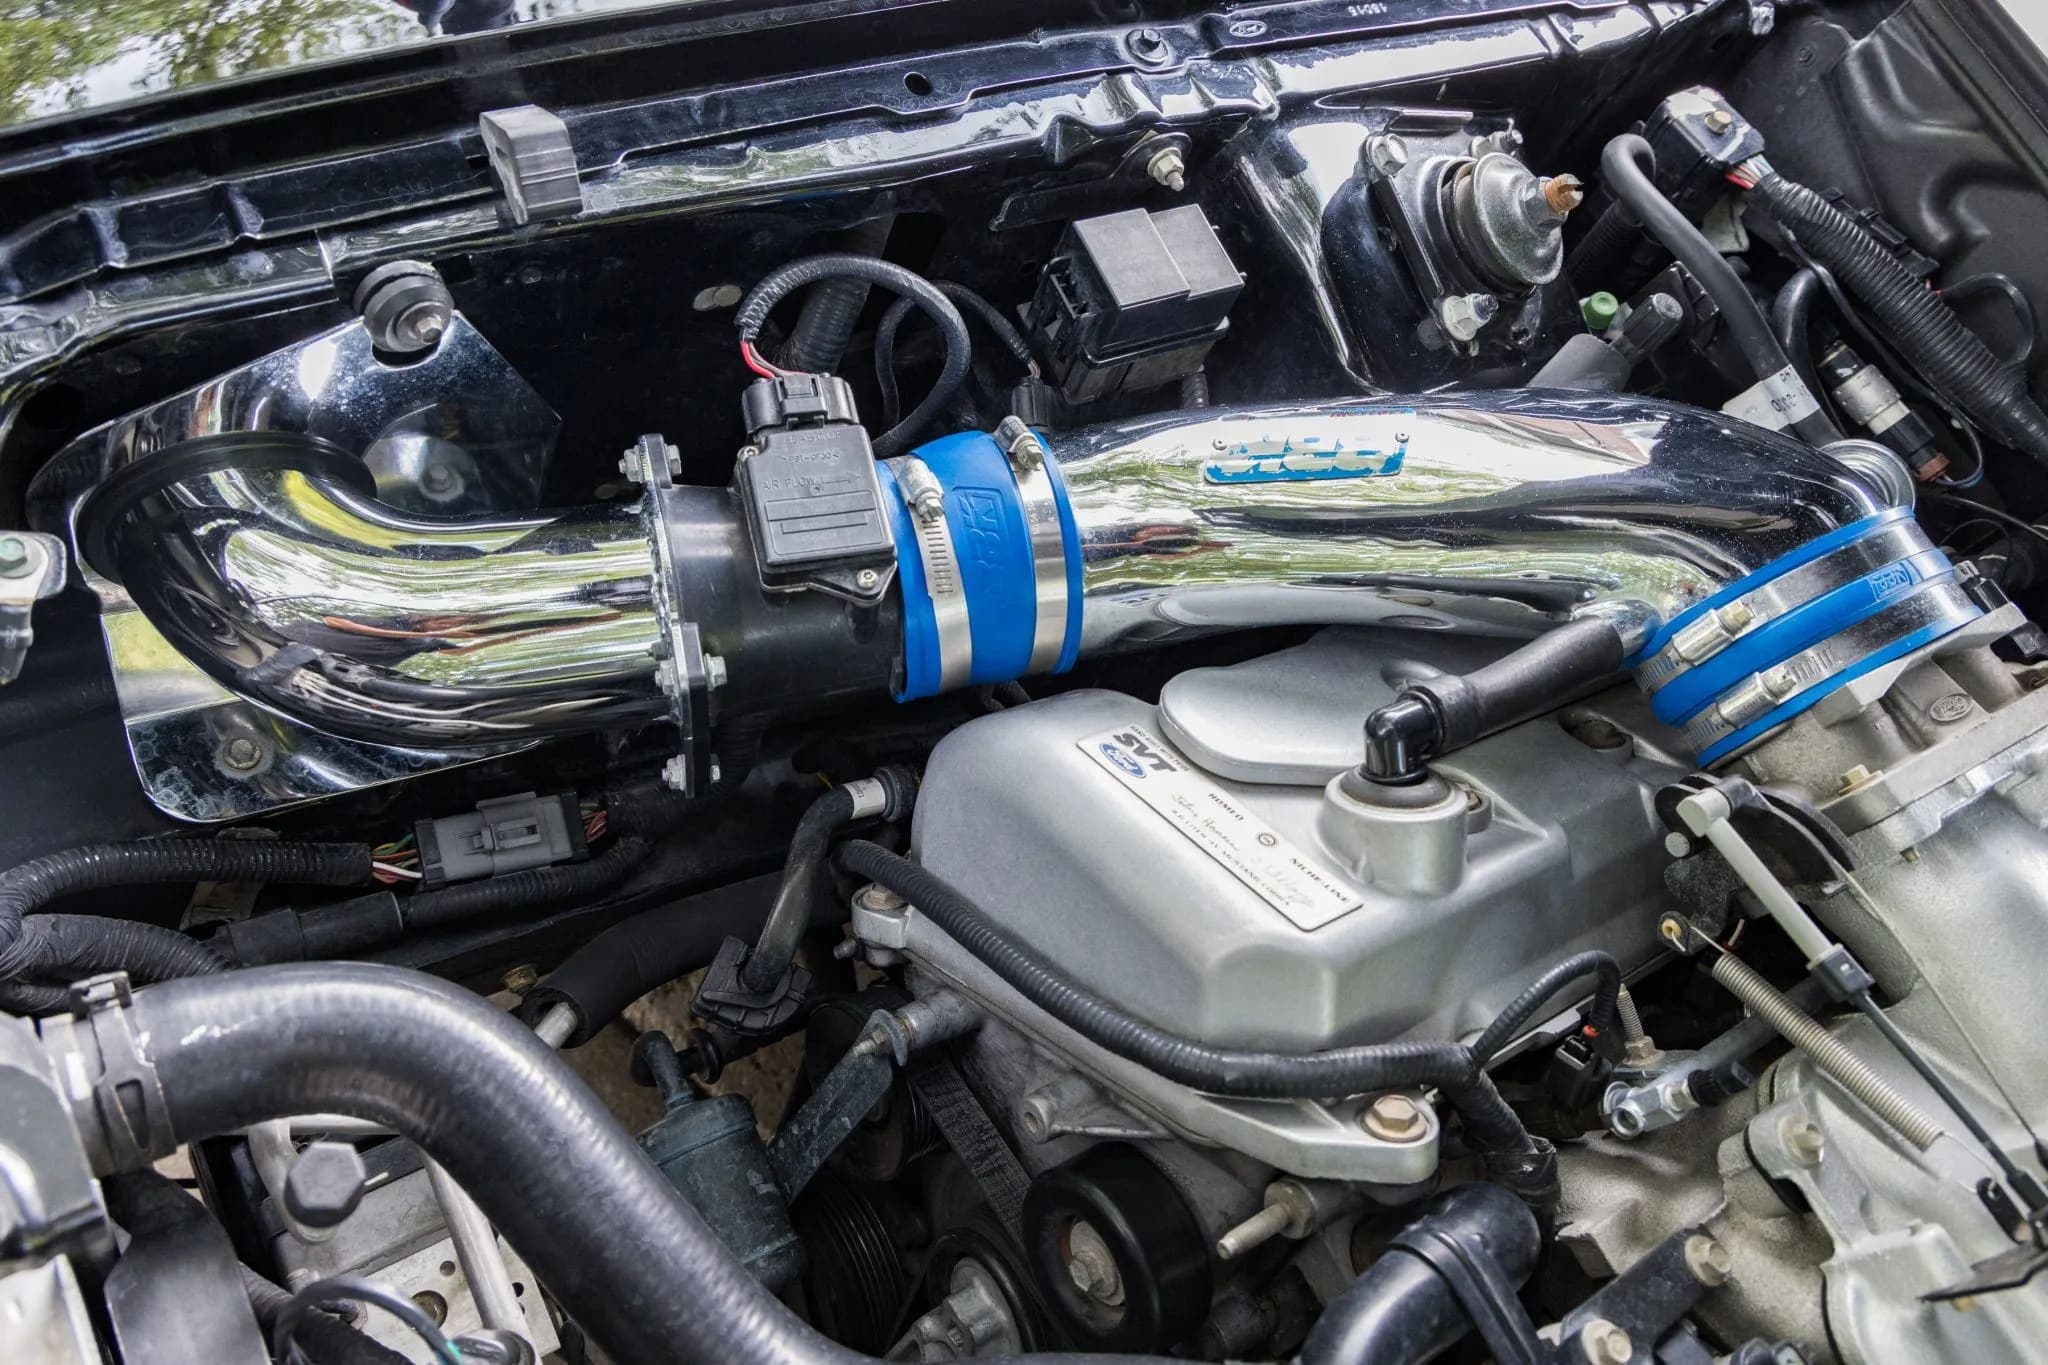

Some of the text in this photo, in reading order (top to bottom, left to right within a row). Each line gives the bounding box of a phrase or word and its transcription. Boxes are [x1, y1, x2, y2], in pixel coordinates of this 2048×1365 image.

[763, 476, 816, 490] AIR FLOW
[1104, 745, 1142, 773] Ford
[1112, 732, 1178, 772] SVT
[1208, 793, 1244, 821] ROMEO
